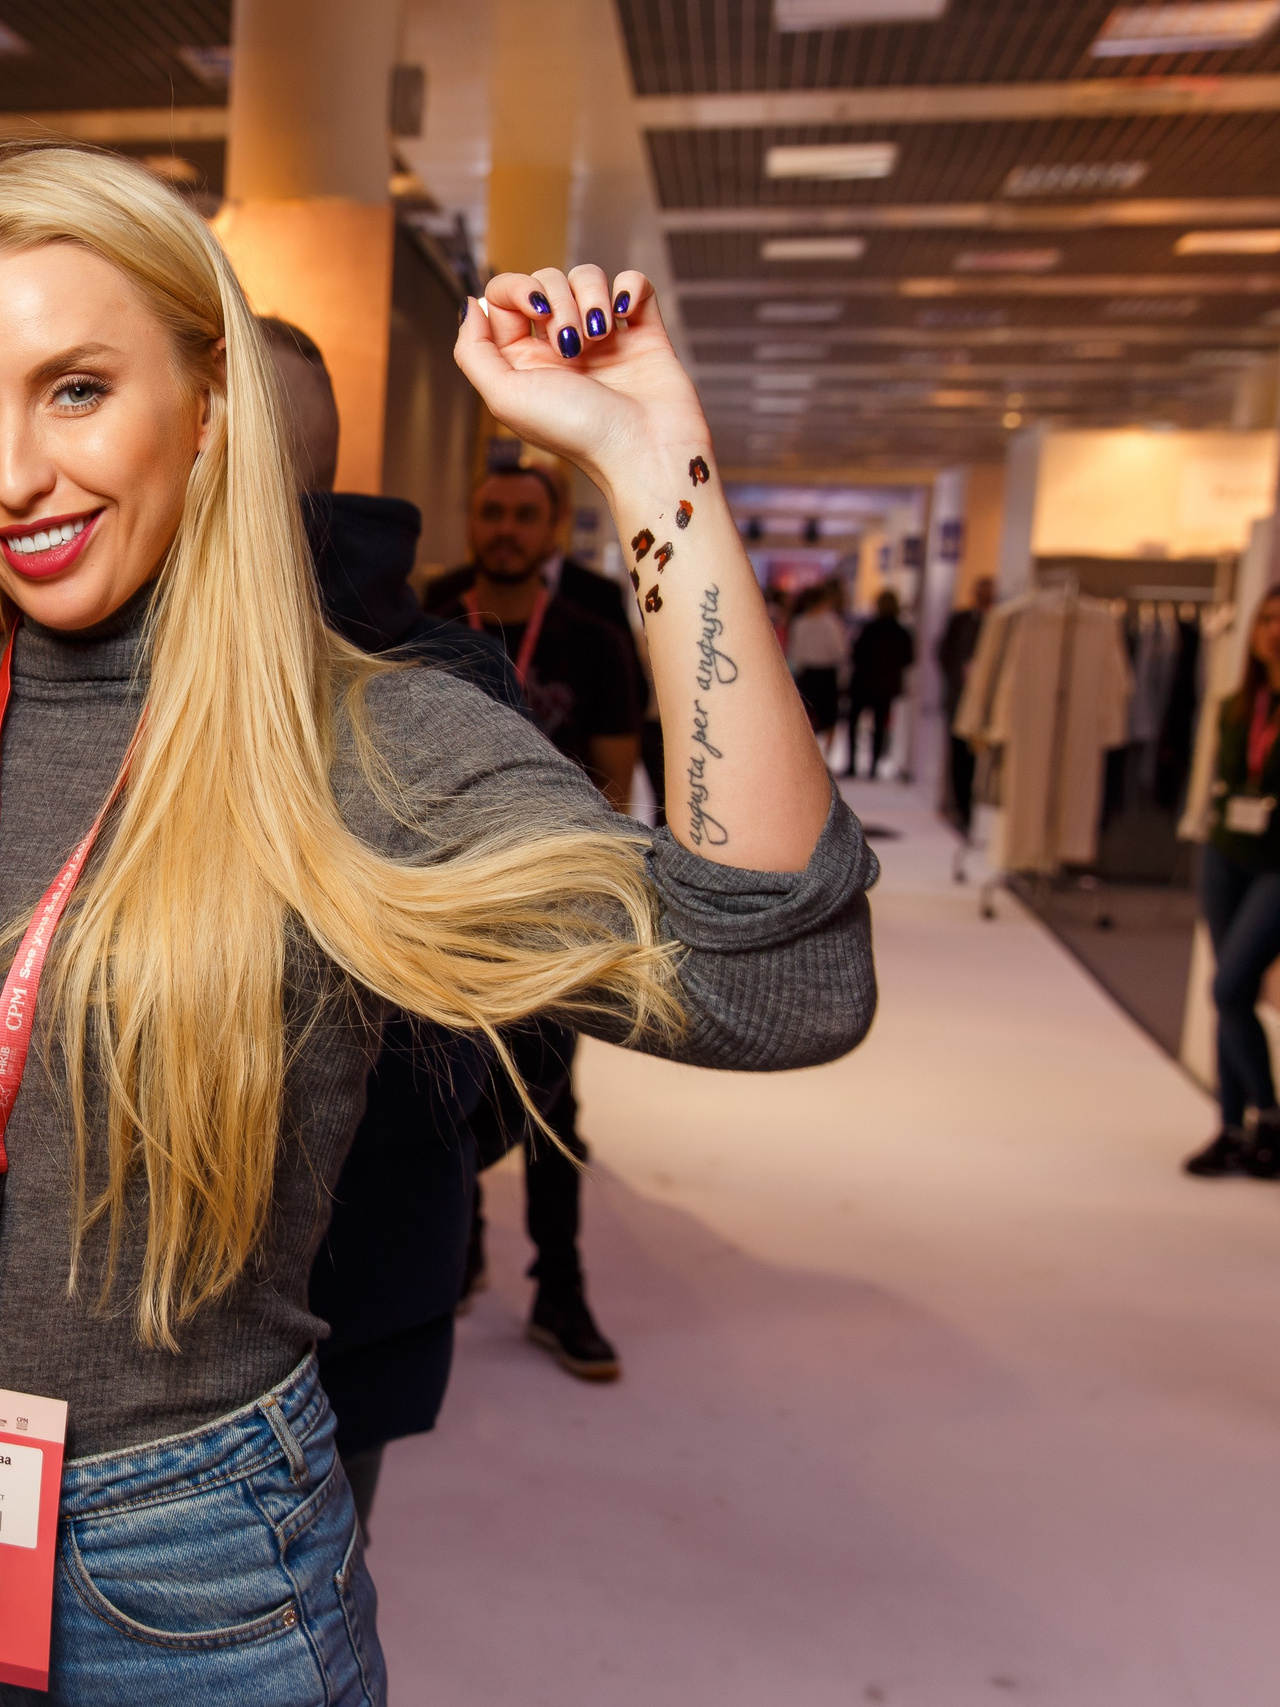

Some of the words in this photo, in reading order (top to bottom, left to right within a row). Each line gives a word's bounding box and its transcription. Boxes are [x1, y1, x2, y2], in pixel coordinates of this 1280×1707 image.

[696, 583, 738, 691] angusta
[691, 699, 723, 759] per
[687, 755, 728, 846] augusta
[19, 948, 37, 979] See
[32, 916, 49, 946] you
[5, 987, 27, 1031] CPM
